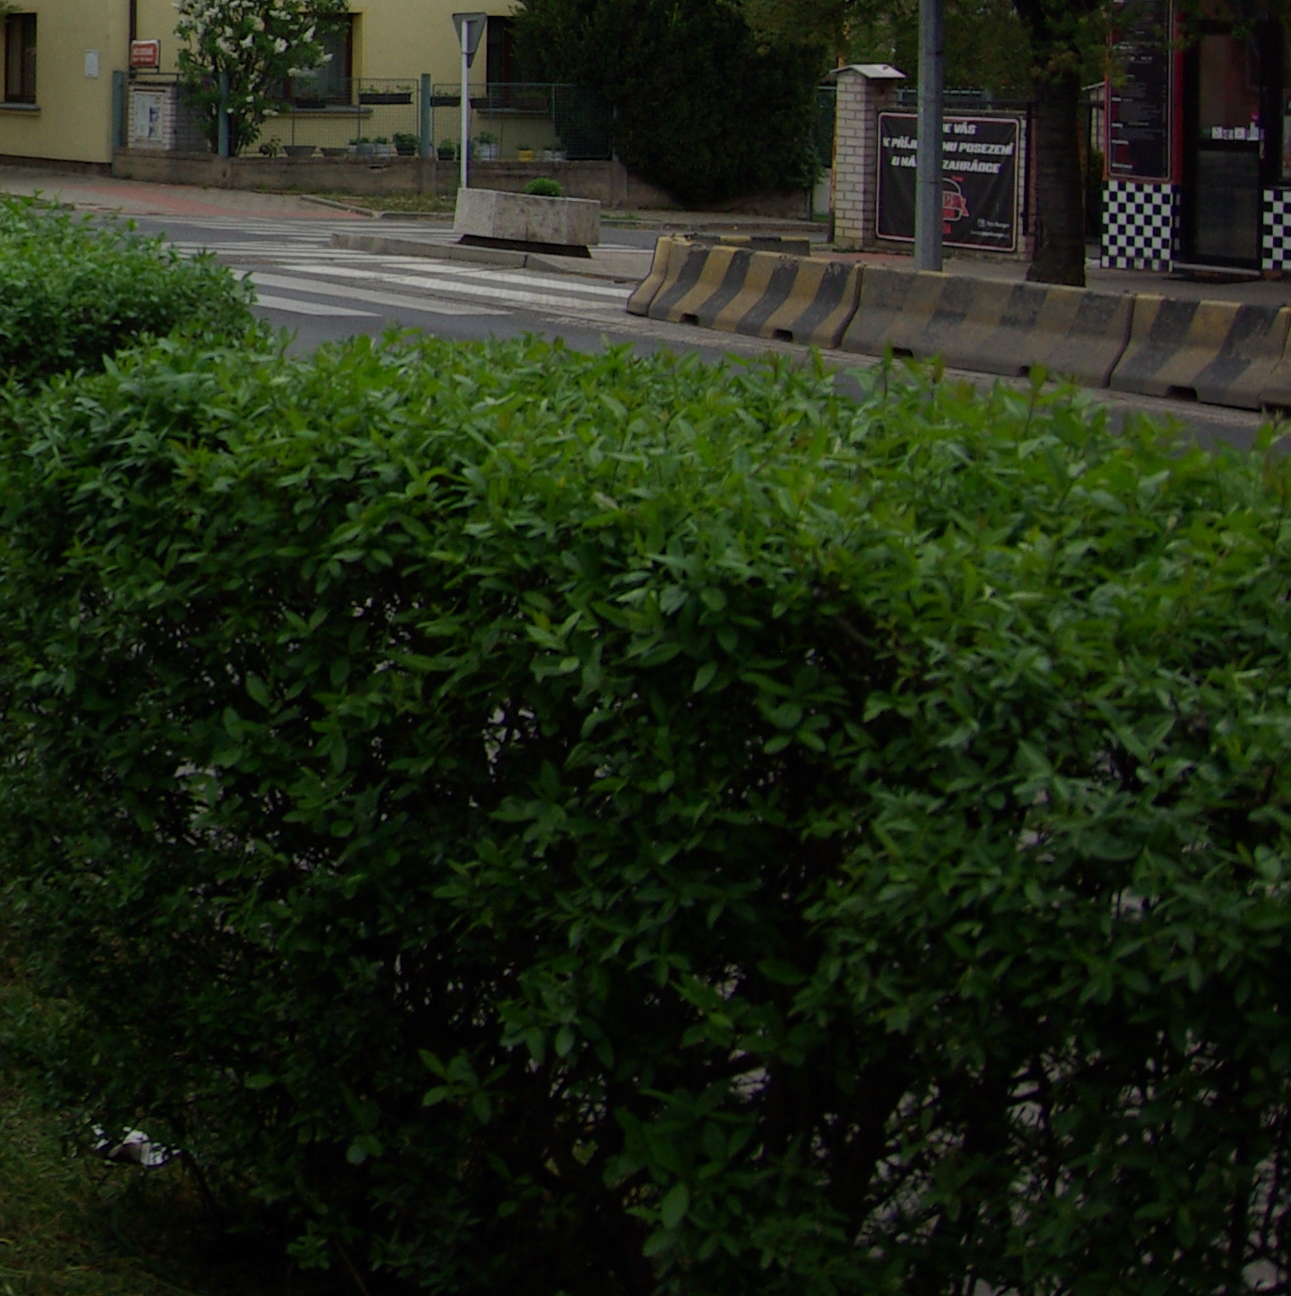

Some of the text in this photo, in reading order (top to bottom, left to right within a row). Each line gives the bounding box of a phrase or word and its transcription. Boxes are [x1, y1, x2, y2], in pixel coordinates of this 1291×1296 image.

[954, 122, 976, 135] VÁS
[883, 137, 891, 147] K
[959, 142, 1014, 155] POSEZENÍ
[891, 155, 900, 166] U
[942, 159, 1002, 173] ZAHRÁDCE
